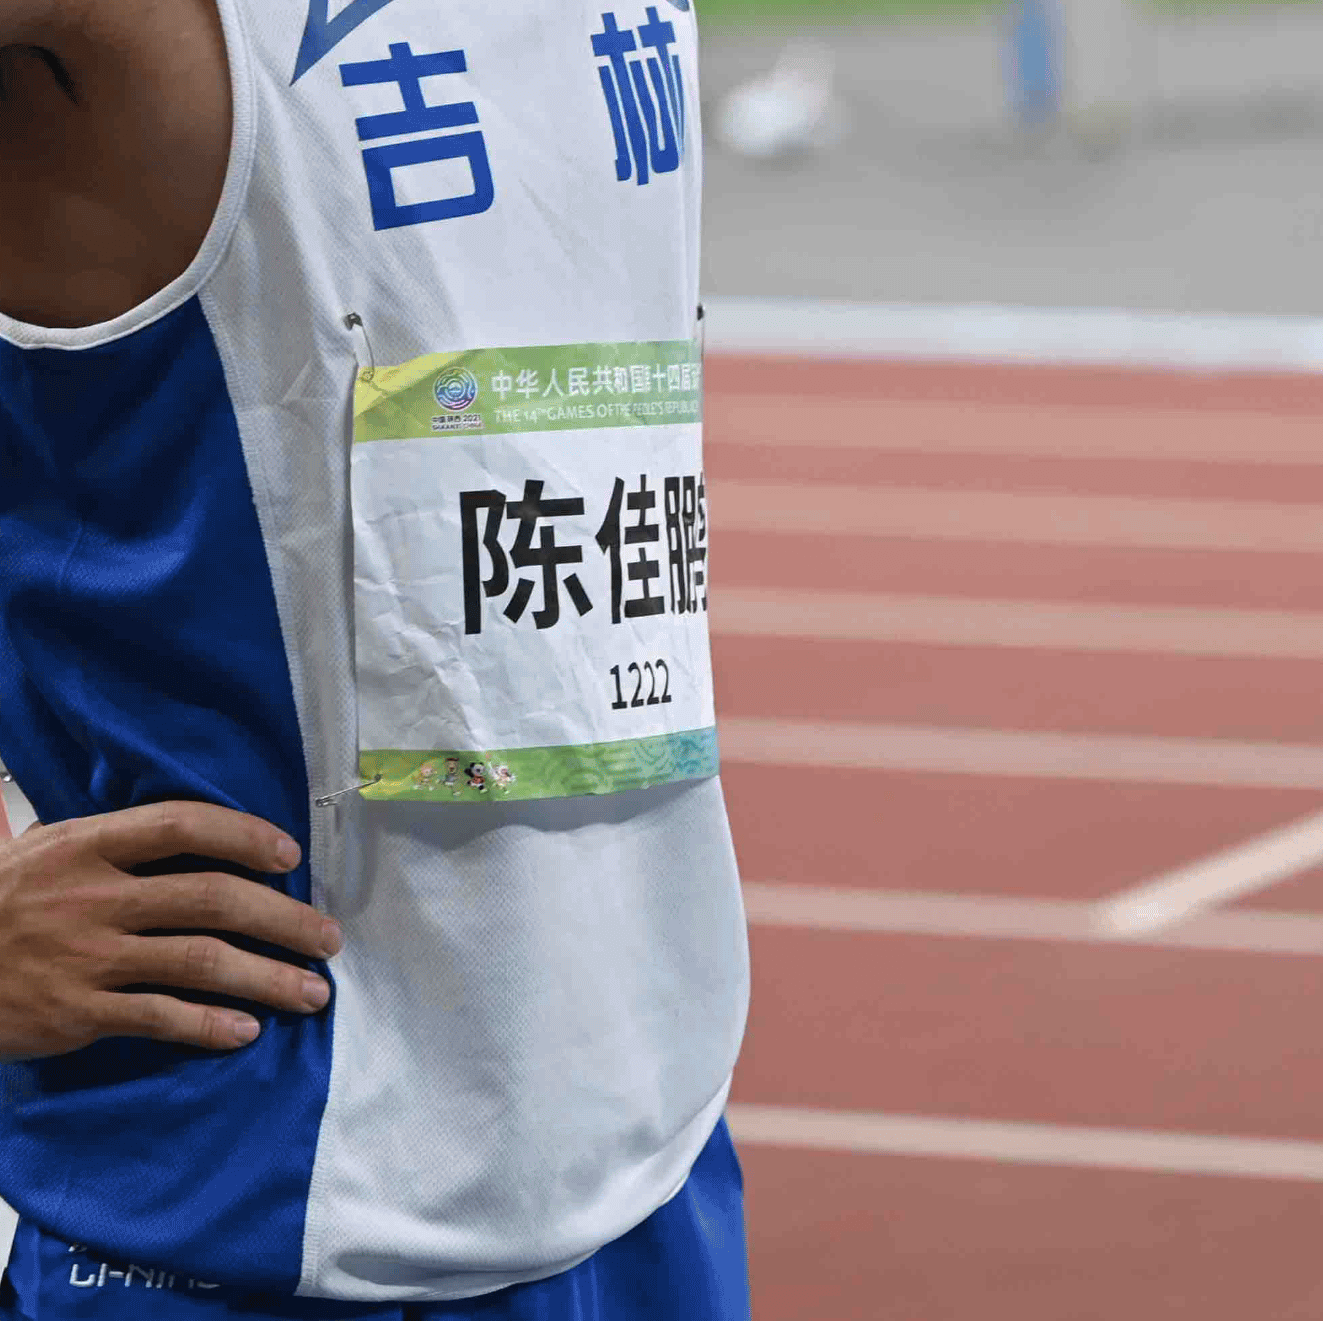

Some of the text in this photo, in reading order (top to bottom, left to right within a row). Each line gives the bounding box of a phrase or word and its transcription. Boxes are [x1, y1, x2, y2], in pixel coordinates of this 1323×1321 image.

[338, 6, 685, 232] 吉林
[493, 408, 521, 423] THE
[547, 404, 595, 420] GAMES
[596, 402, 614, 418] OF
[459, 472, 707, 635] 陈佳鹏
[609, 658, 672, 710] 1222
